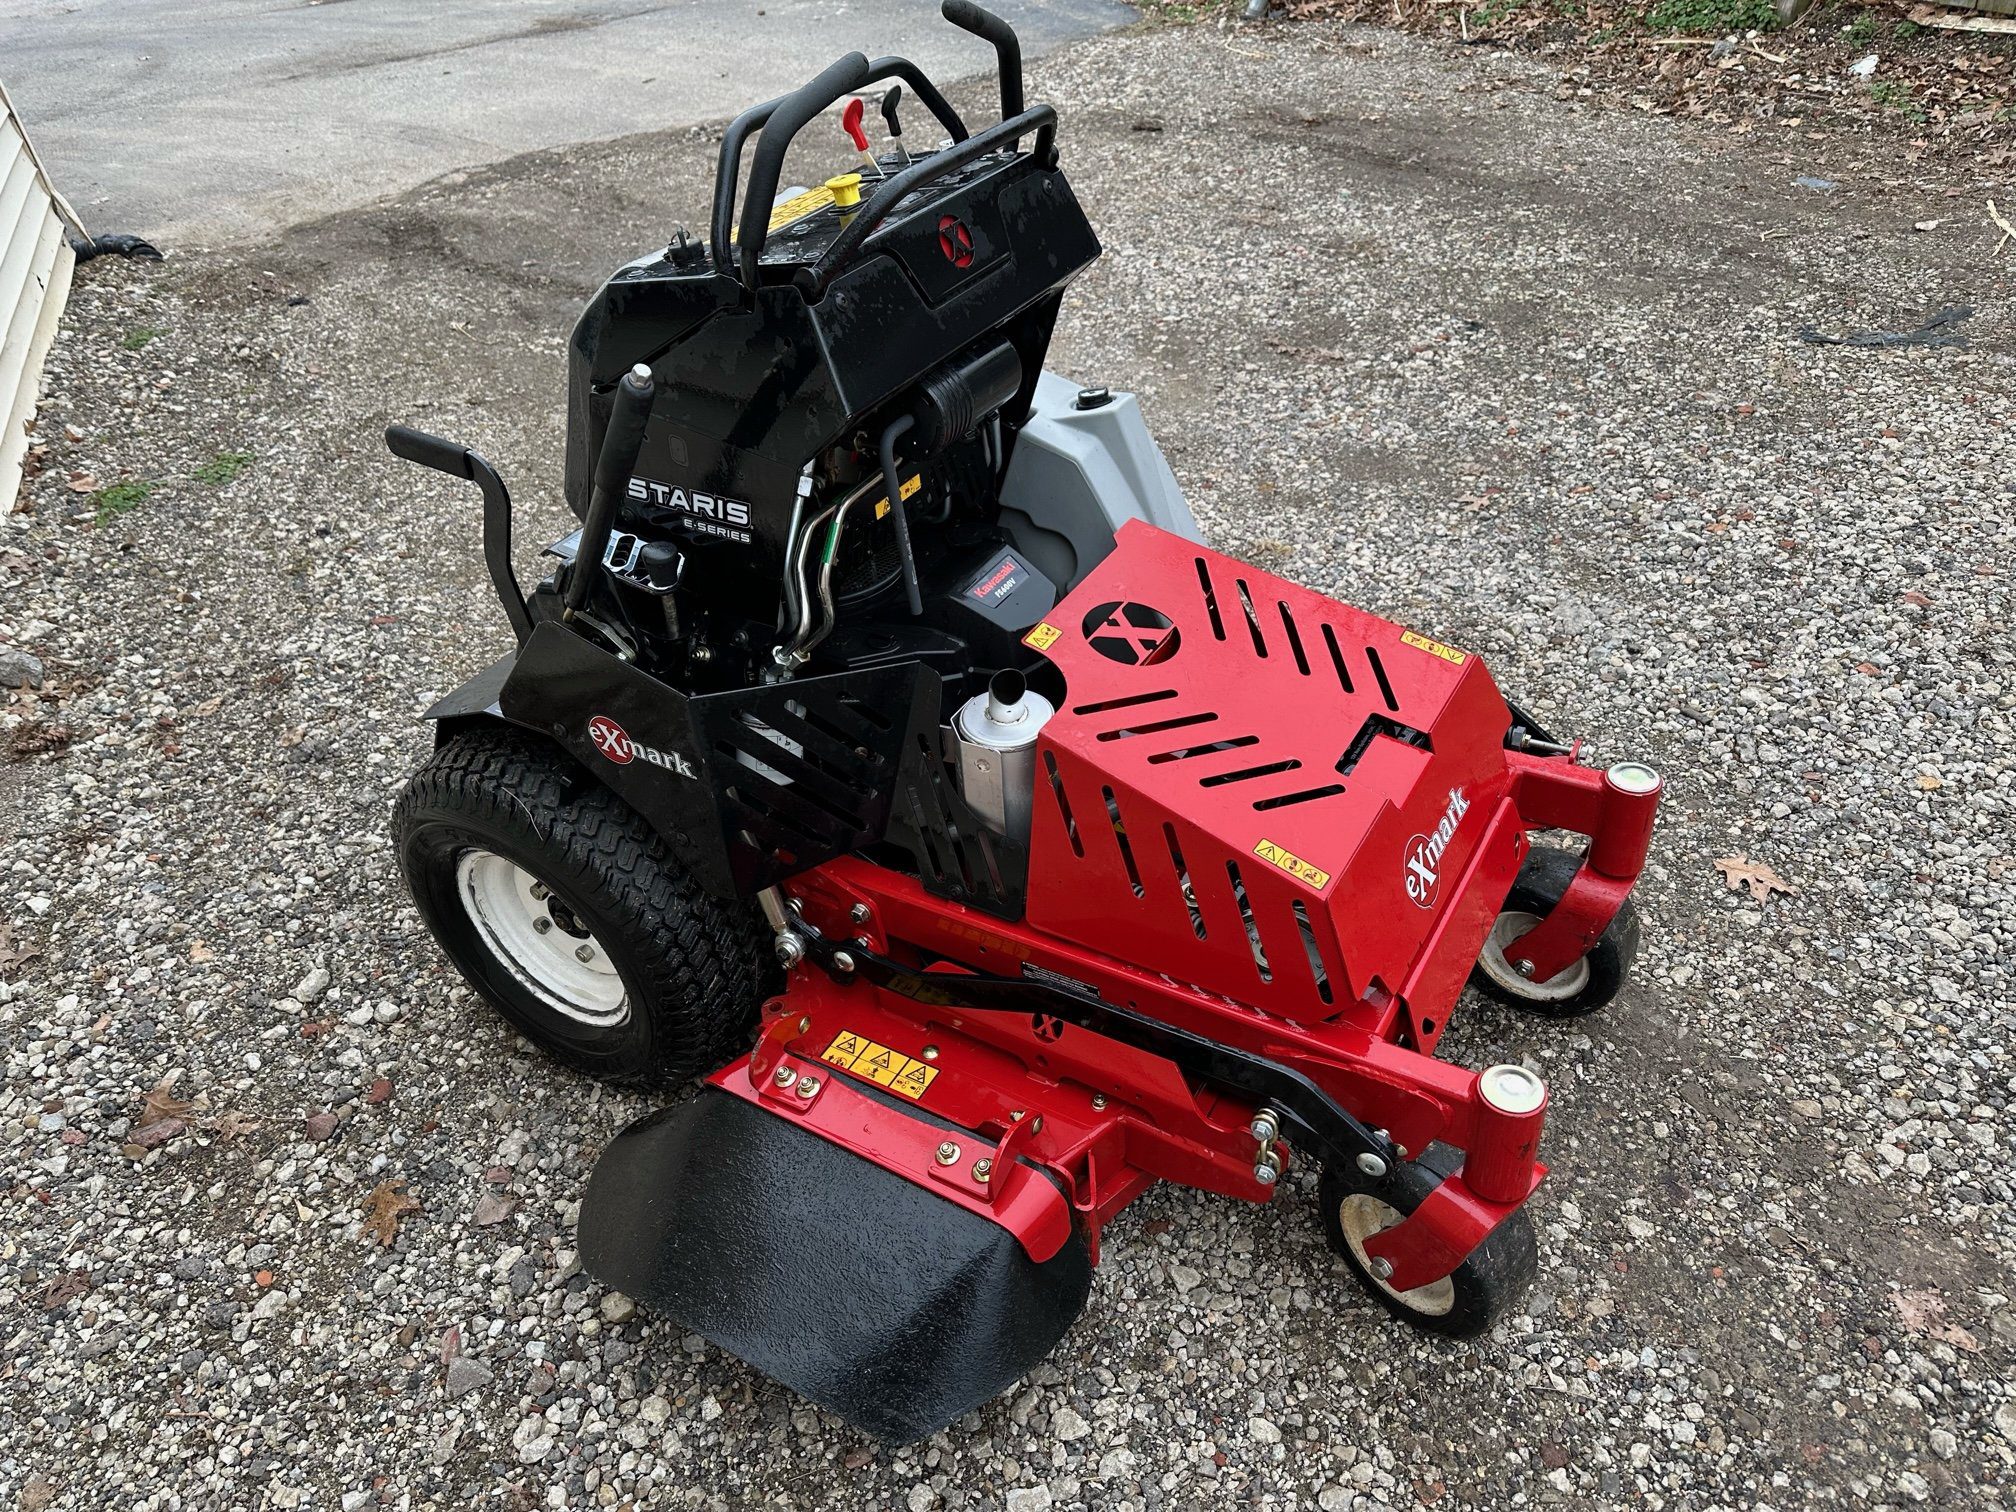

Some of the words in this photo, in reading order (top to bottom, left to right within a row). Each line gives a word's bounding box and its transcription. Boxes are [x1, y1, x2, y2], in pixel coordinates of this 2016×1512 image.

[938, 214, 975, 268] X
[628, 477, 749, 525] STARIS
[973, 561, 1016, 599] Kawasaki
[1082, 600, 1182, 667] X
[588, 721, 698, 781] eXmark
[1405, 786, 1471, 903] eXmark
